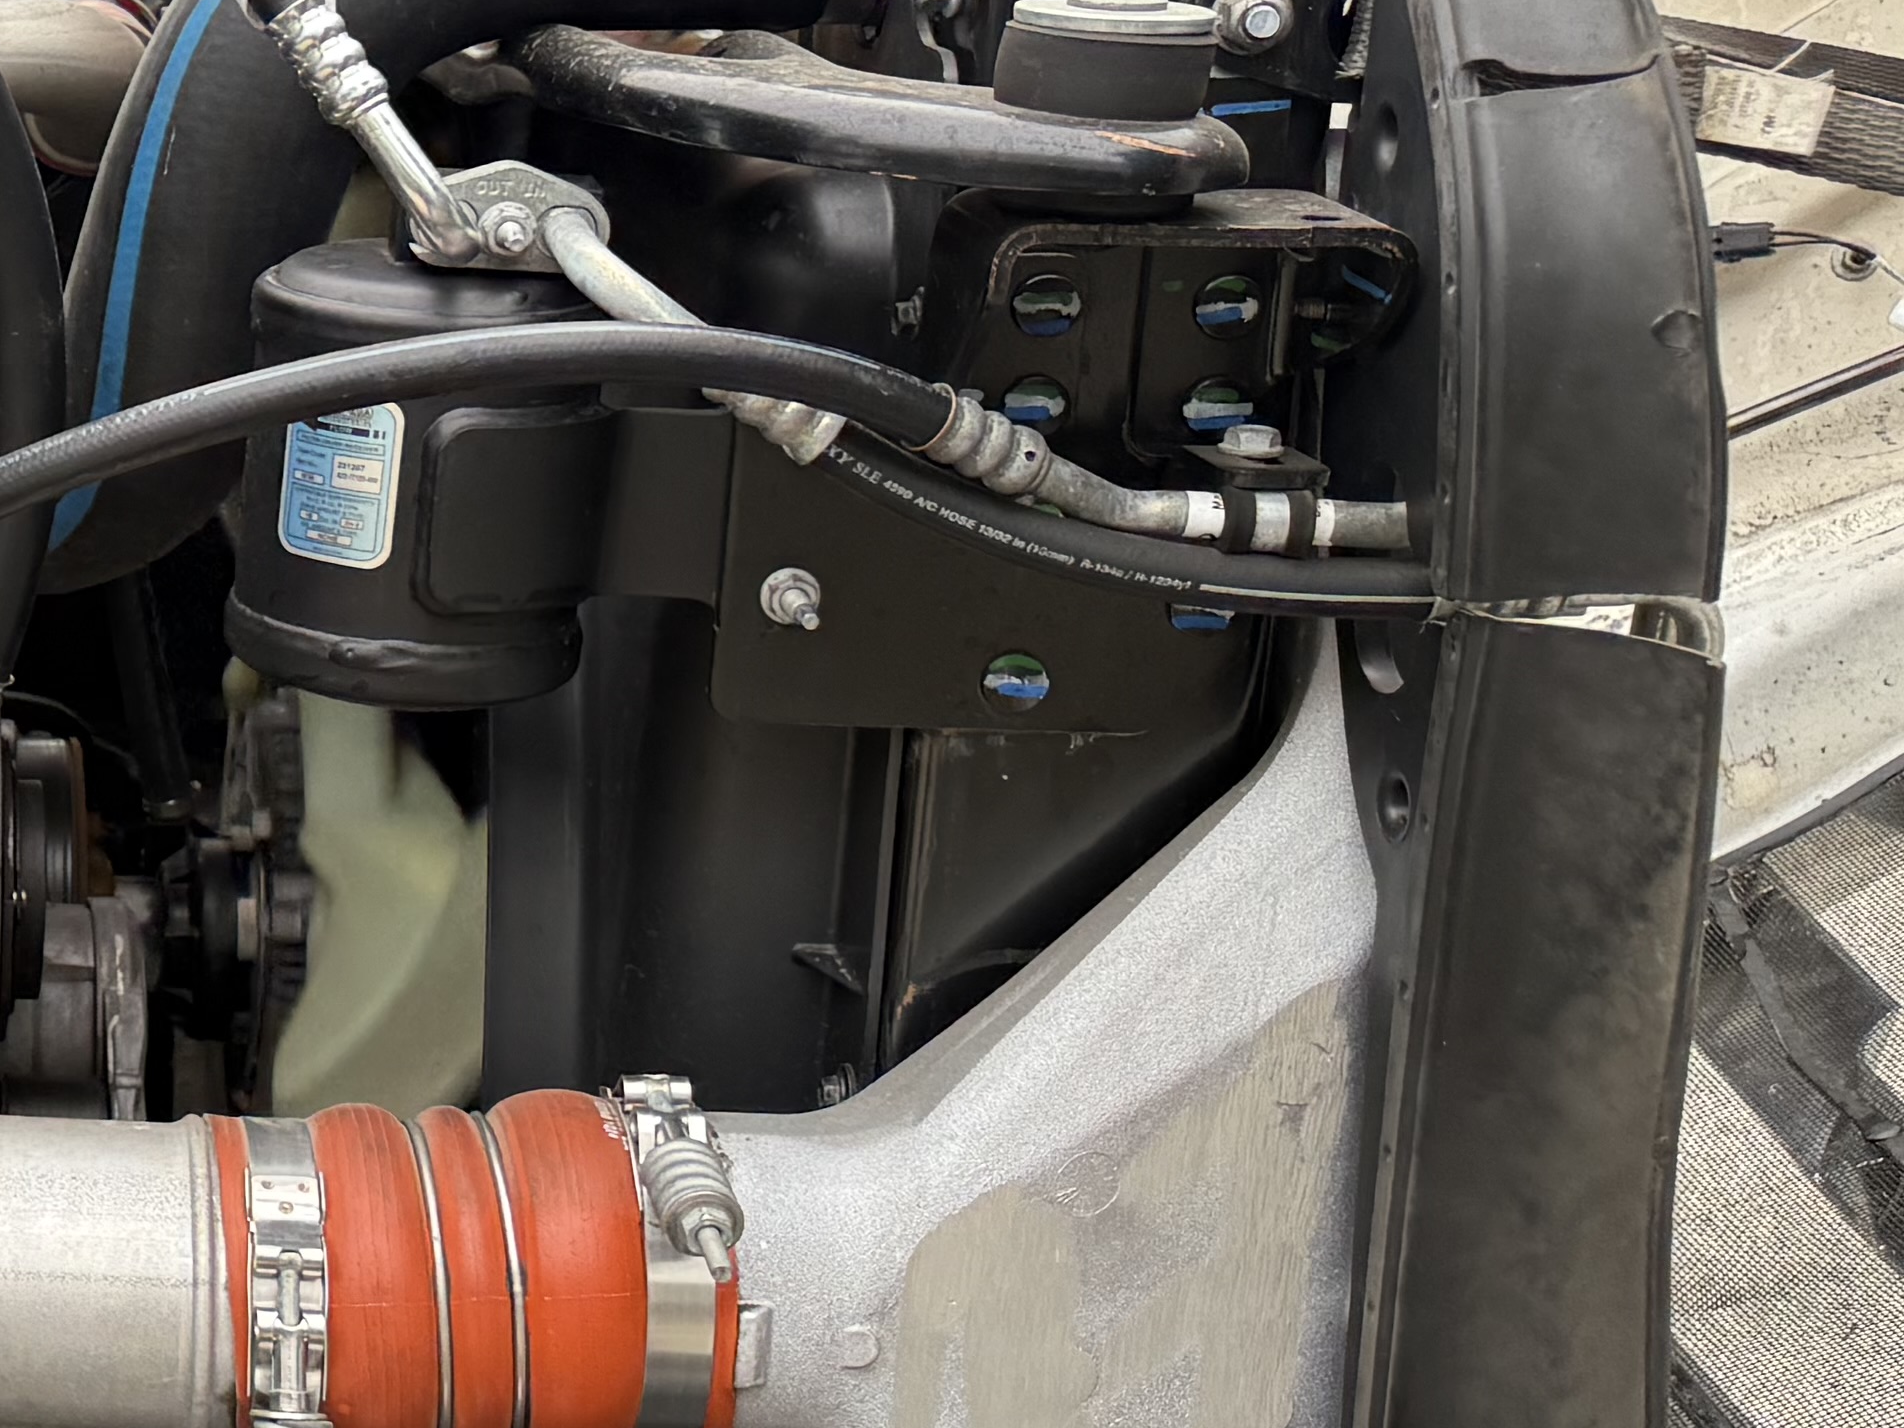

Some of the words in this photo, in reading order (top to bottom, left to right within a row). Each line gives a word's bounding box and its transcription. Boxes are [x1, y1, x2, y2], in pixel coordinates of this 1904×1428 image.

[477, 180, 514, 196] OUT
[852, 462, 883, 486] SLE
[913, 495, 939, 513] A/C
[938, 505, 977, 531] HOSE
